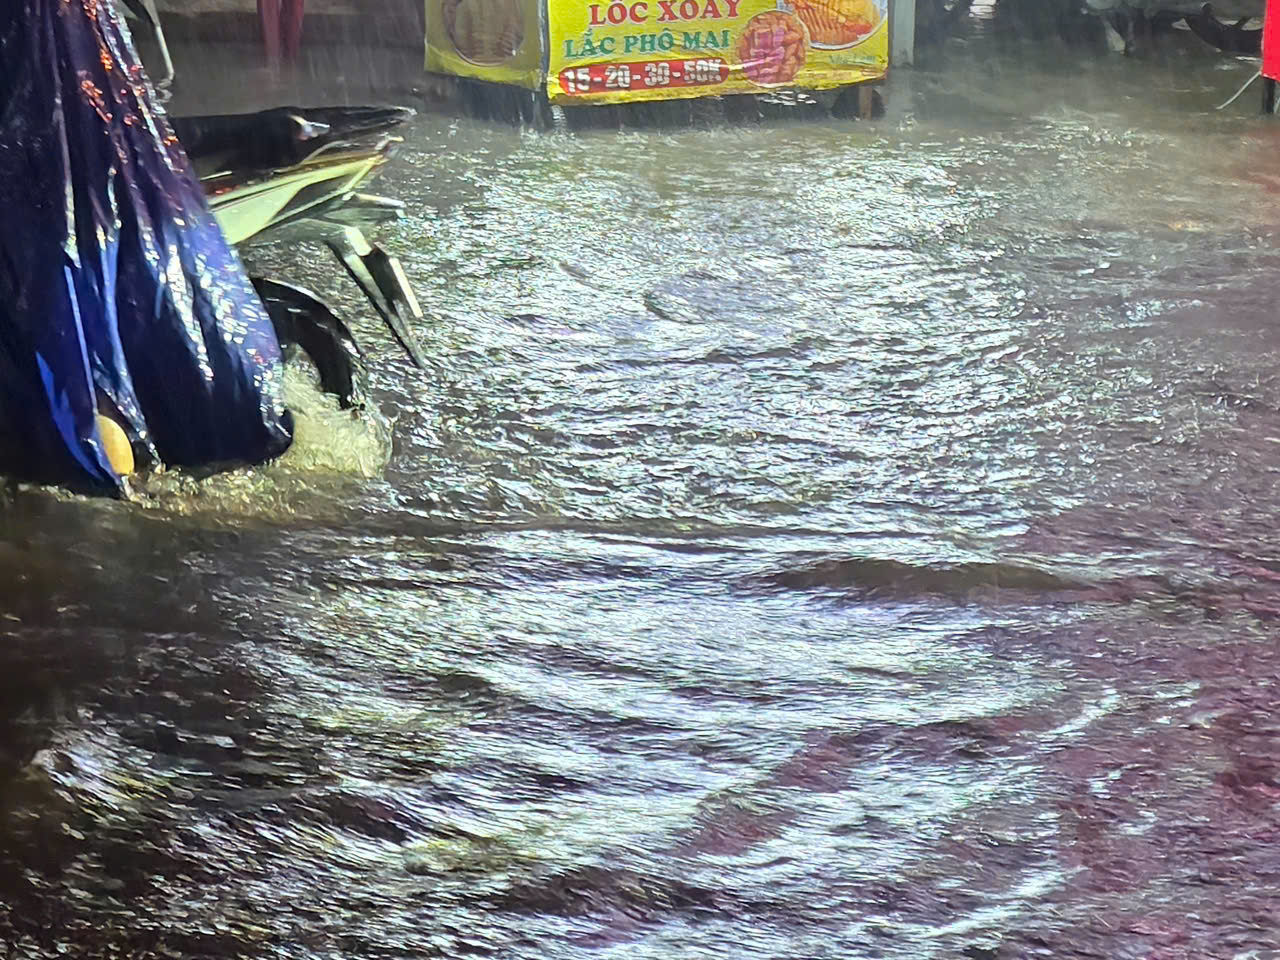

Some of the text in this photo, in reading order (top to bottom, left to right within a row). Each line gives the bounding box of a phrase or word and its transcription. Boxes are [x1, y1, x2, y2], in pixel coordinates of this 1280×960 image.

[563, 27, 732, 58] LẮC PHÔ MAI
